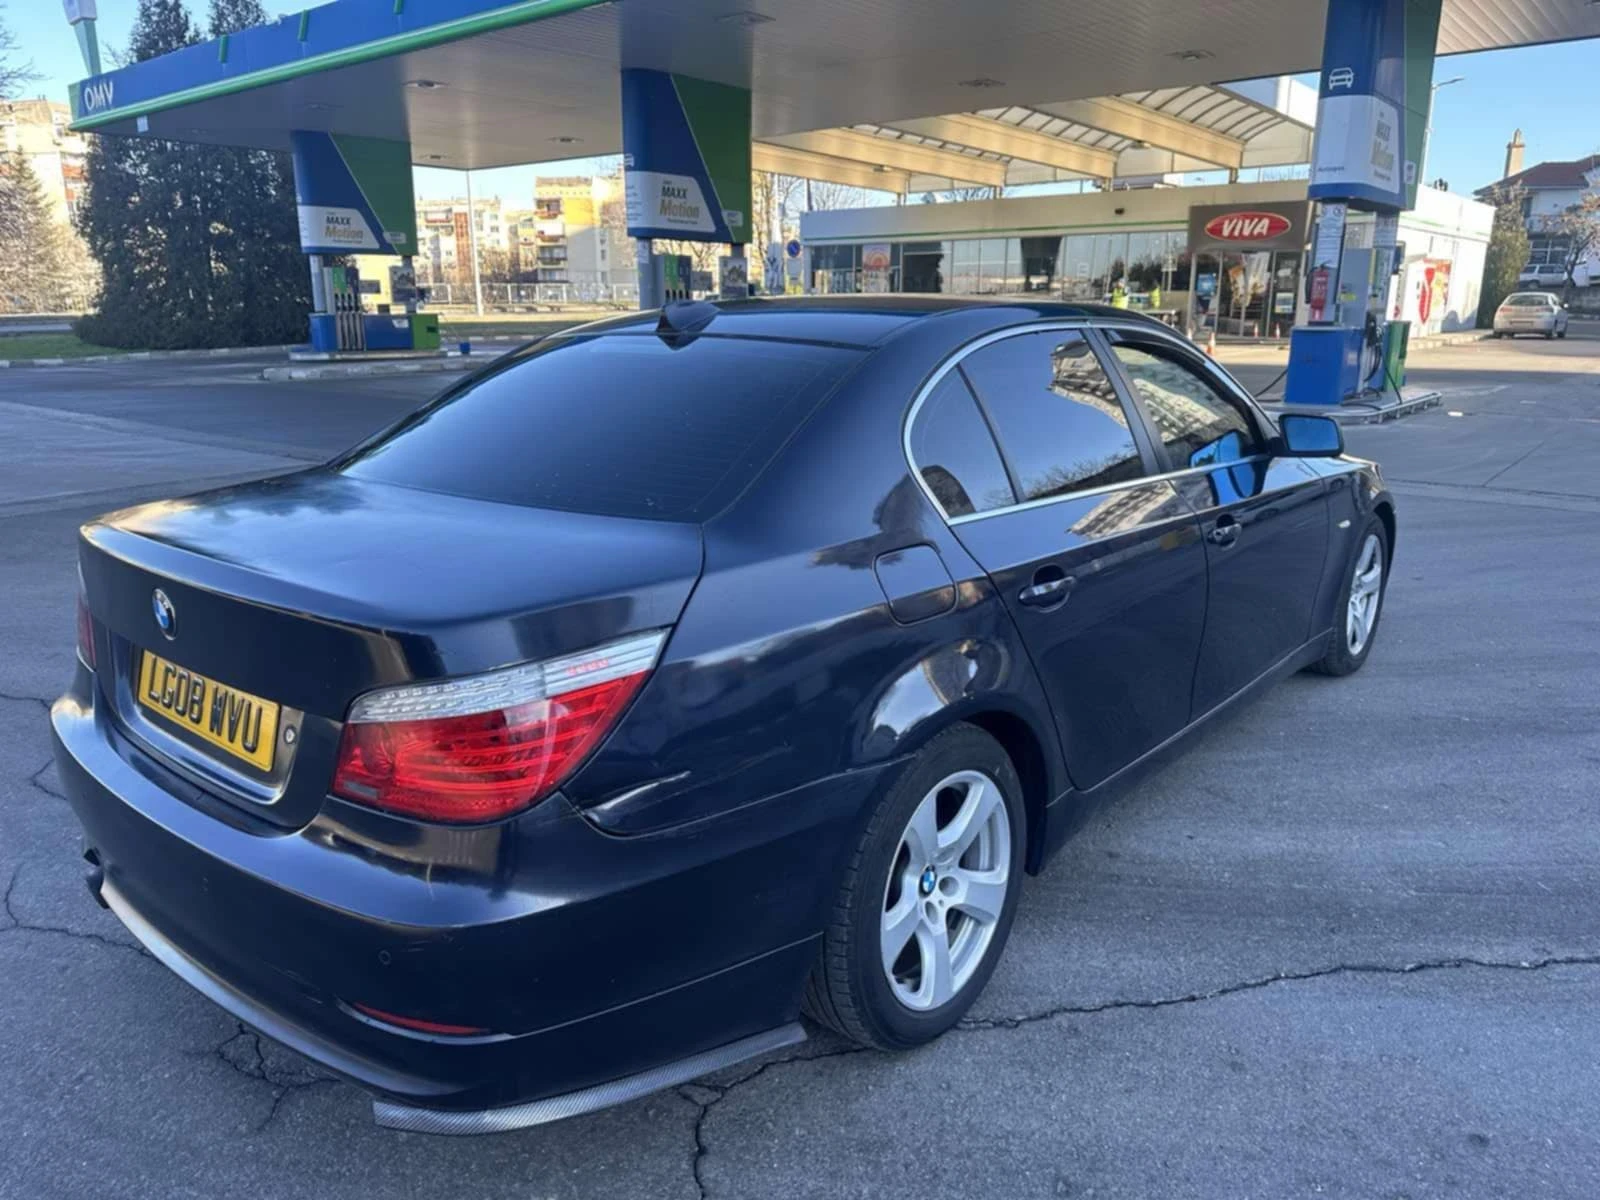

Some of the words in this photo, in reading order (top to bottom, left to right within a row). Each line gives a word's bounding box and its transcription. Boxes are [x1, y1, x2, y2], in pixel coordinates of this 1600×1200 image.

[84, 80, 114, 111] OMV
[661, 185, 688, 199] MAXX
[659, 199, 700, 218] Motion
[326, 215, 352, 225] MAXX
[1222, 218, 1270, 237] VIVA
[324, 225, 364, 239] Motion
[148, 655, 206, 725] LG08
[209, 683, 263, 753] WVU
